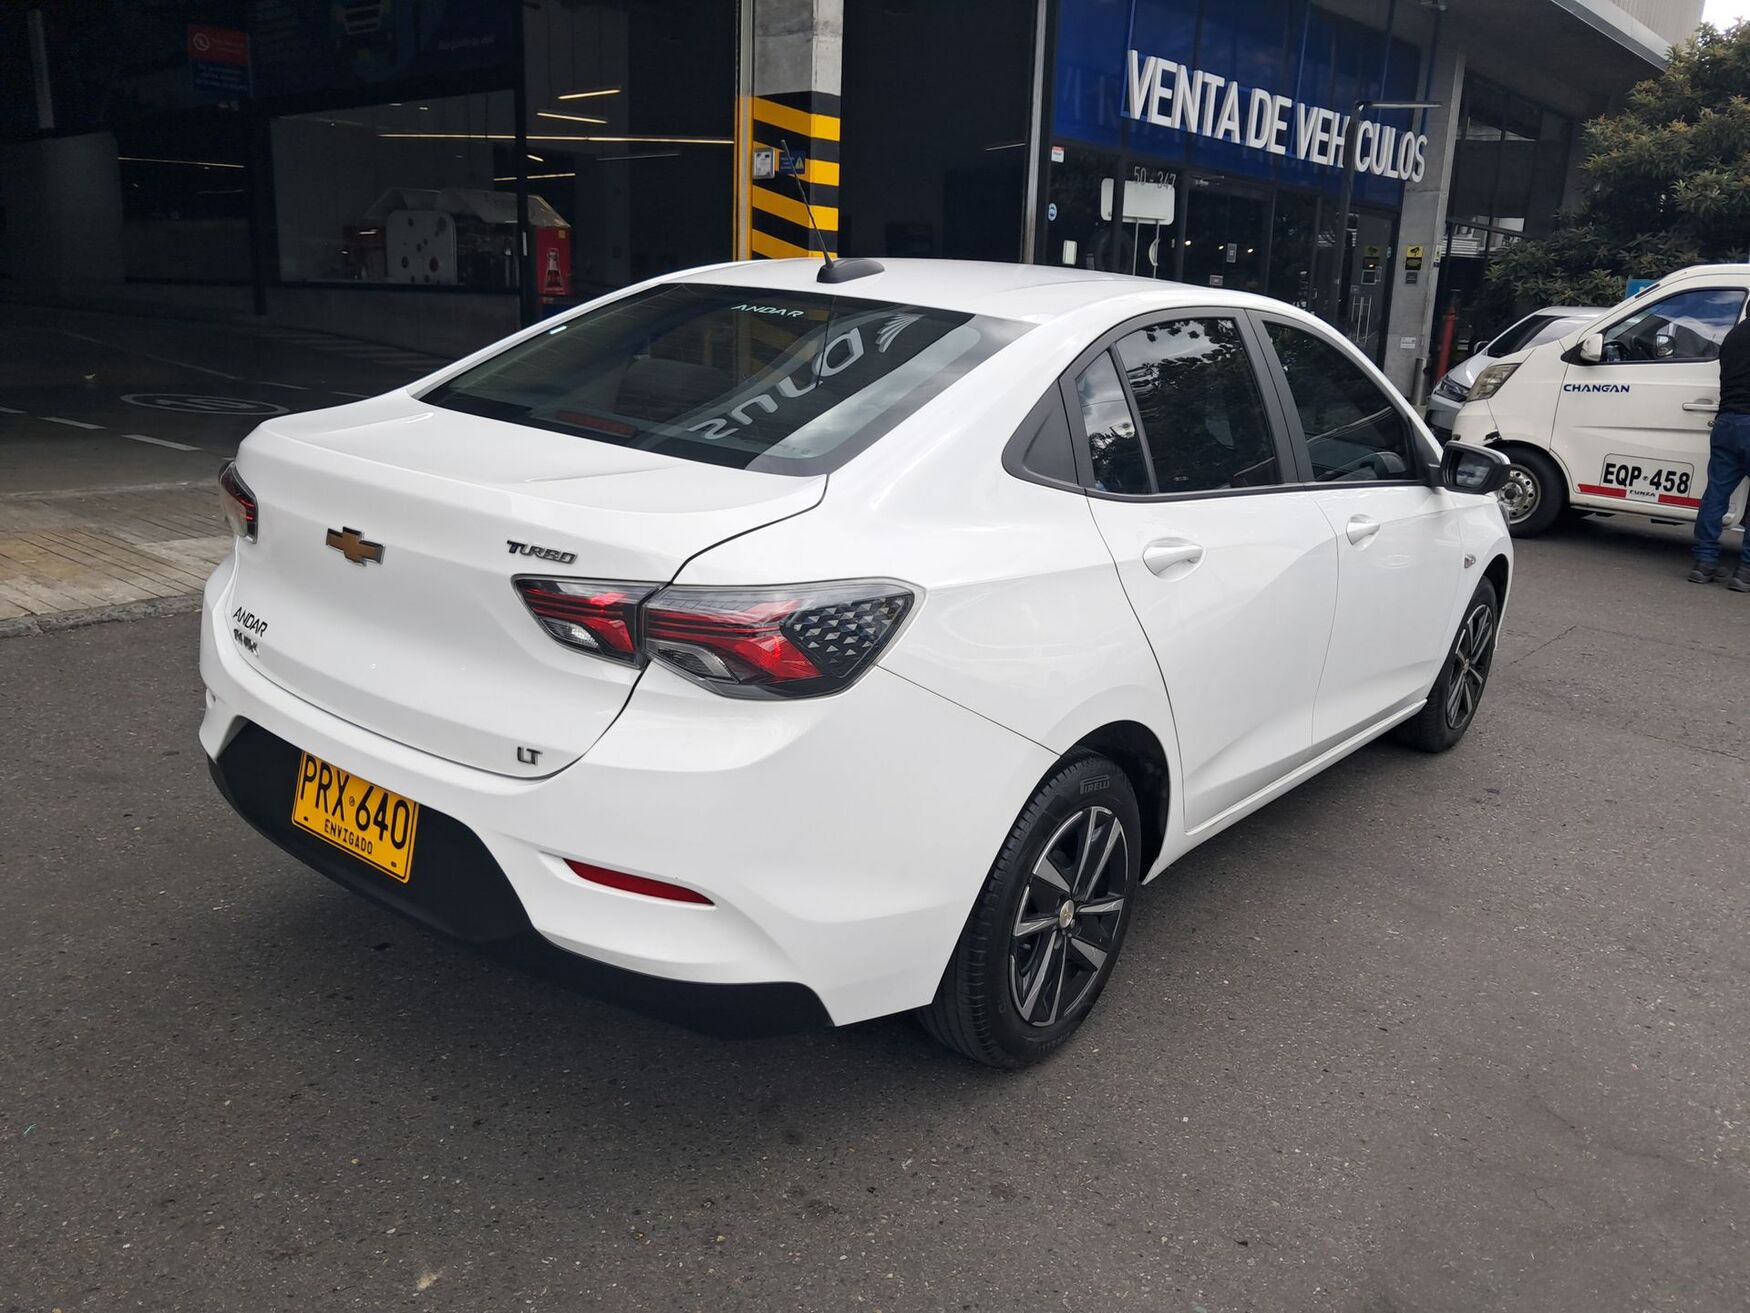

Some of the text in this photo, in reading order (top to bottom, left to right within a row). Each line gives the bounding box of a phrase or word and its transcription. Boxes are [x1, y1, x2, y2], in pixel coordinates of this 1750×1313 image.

[1128, 49, 1427, 183] VENTA DE VEHCULOS
[1134, 166, 1146, 186] 50
[1157, 171, 1176, 190] 347
[730, 304, 804, 318] ANDAR
[1563, 383, 1630, 393] CHANGAN
[1603, 462, 1690, 494] EQP 458
[506, 540, 578, 565] TURBO
[233, 606, 268, 638] ANDAR
[517, 746, 543, 766] LT
[1079, 774, 1110, 795] PIRELLI
[300, 754, 411, 850] PRX 640
[324, 818, 373, 855] ENVIGADO
